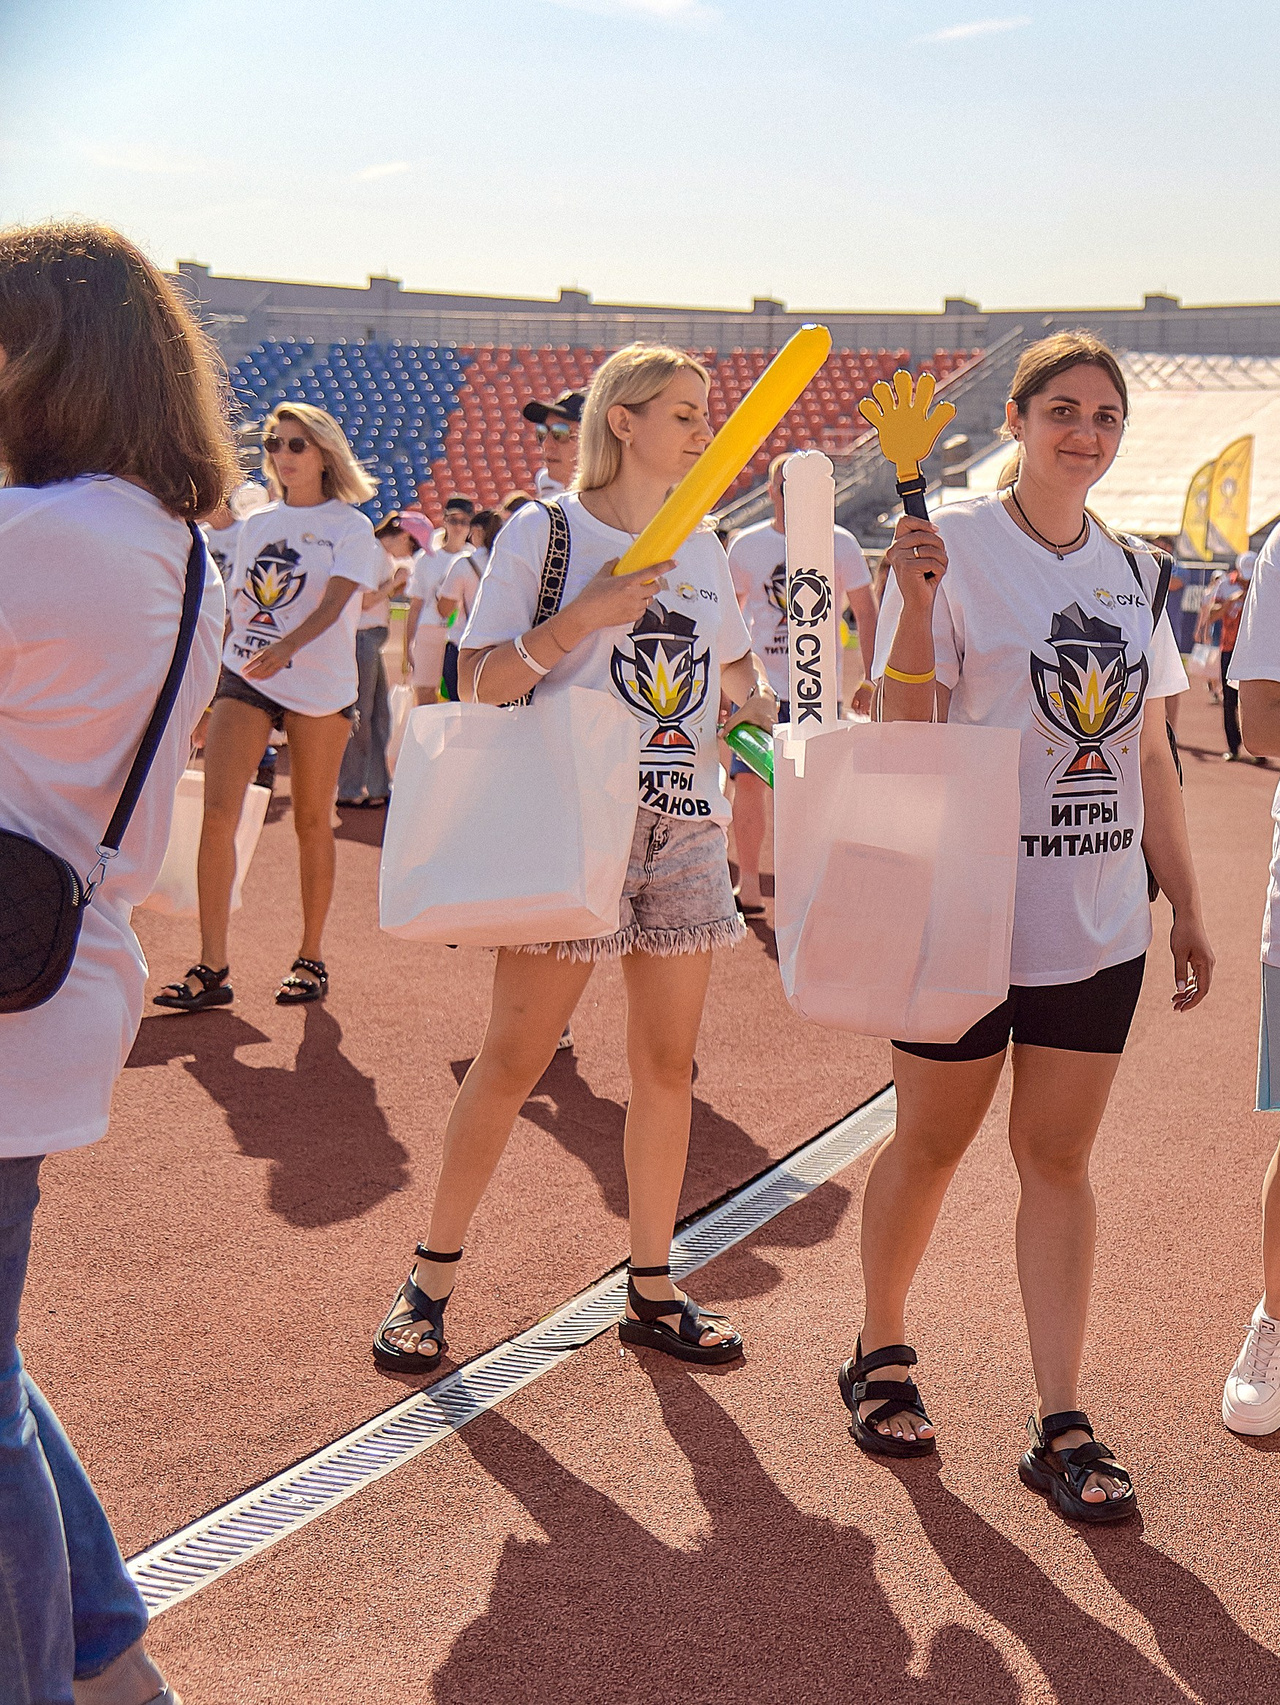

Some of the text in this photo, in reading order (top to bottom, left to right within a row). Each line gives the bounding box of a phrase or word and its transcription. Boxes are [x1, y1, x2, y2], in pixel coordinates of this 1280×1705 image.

[1117, 594, 1145, 607] СУК
[796, 634, 822, 725] СУЭК
[639, 771, 694, 792] ИГРЫ
[641, 785, 711, 816] ТАНОВ
[1051, 801, 1118, 826] ИГРЫ
[1021, 828, 1134, 857] ТИТАНОВ
